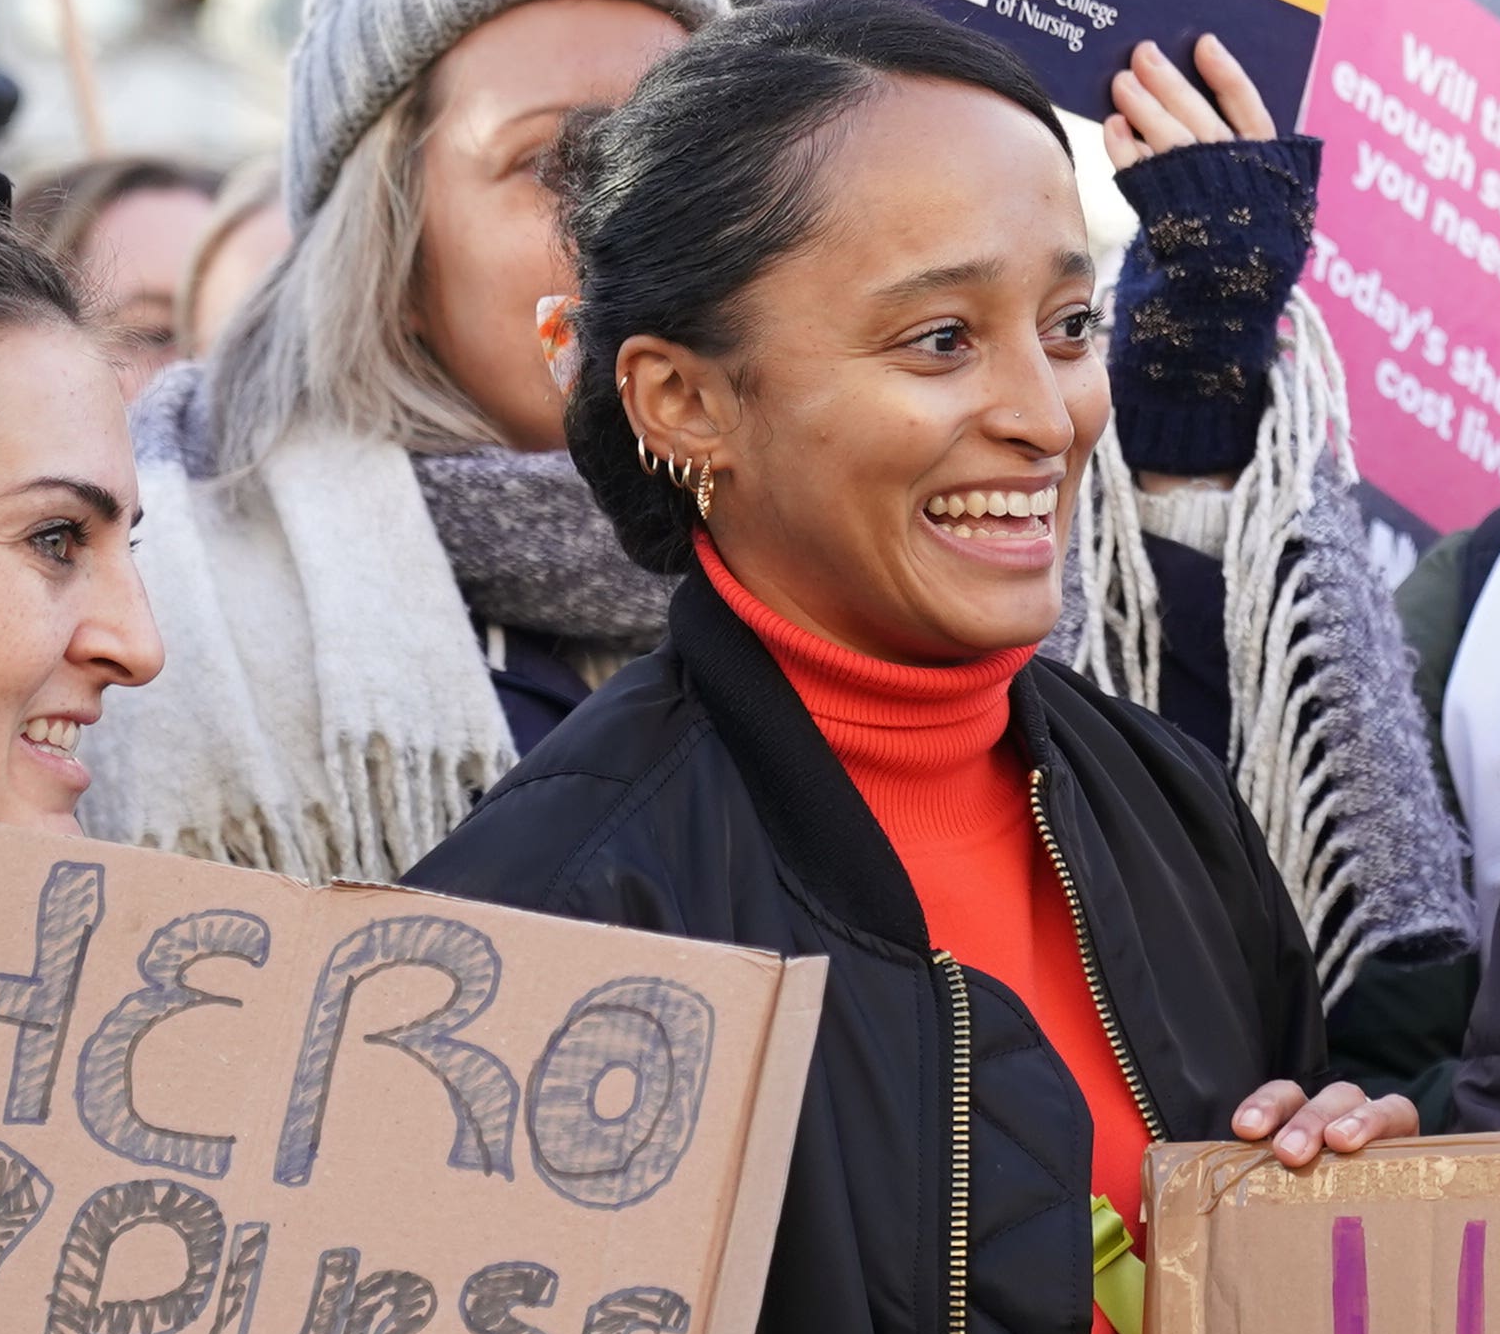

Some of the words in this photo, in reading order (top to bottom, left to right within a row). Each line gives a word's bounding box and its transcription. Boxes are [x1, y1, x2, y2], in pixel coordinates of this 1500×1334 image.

[1018, 0, 1086, 52] Nursing
[1403, 32, 1478, 123] Will
[1332, 61, 1476, 190] enough
[1352, 141, 1429, 220] you
[1375, 358, 1455, 441] cost
